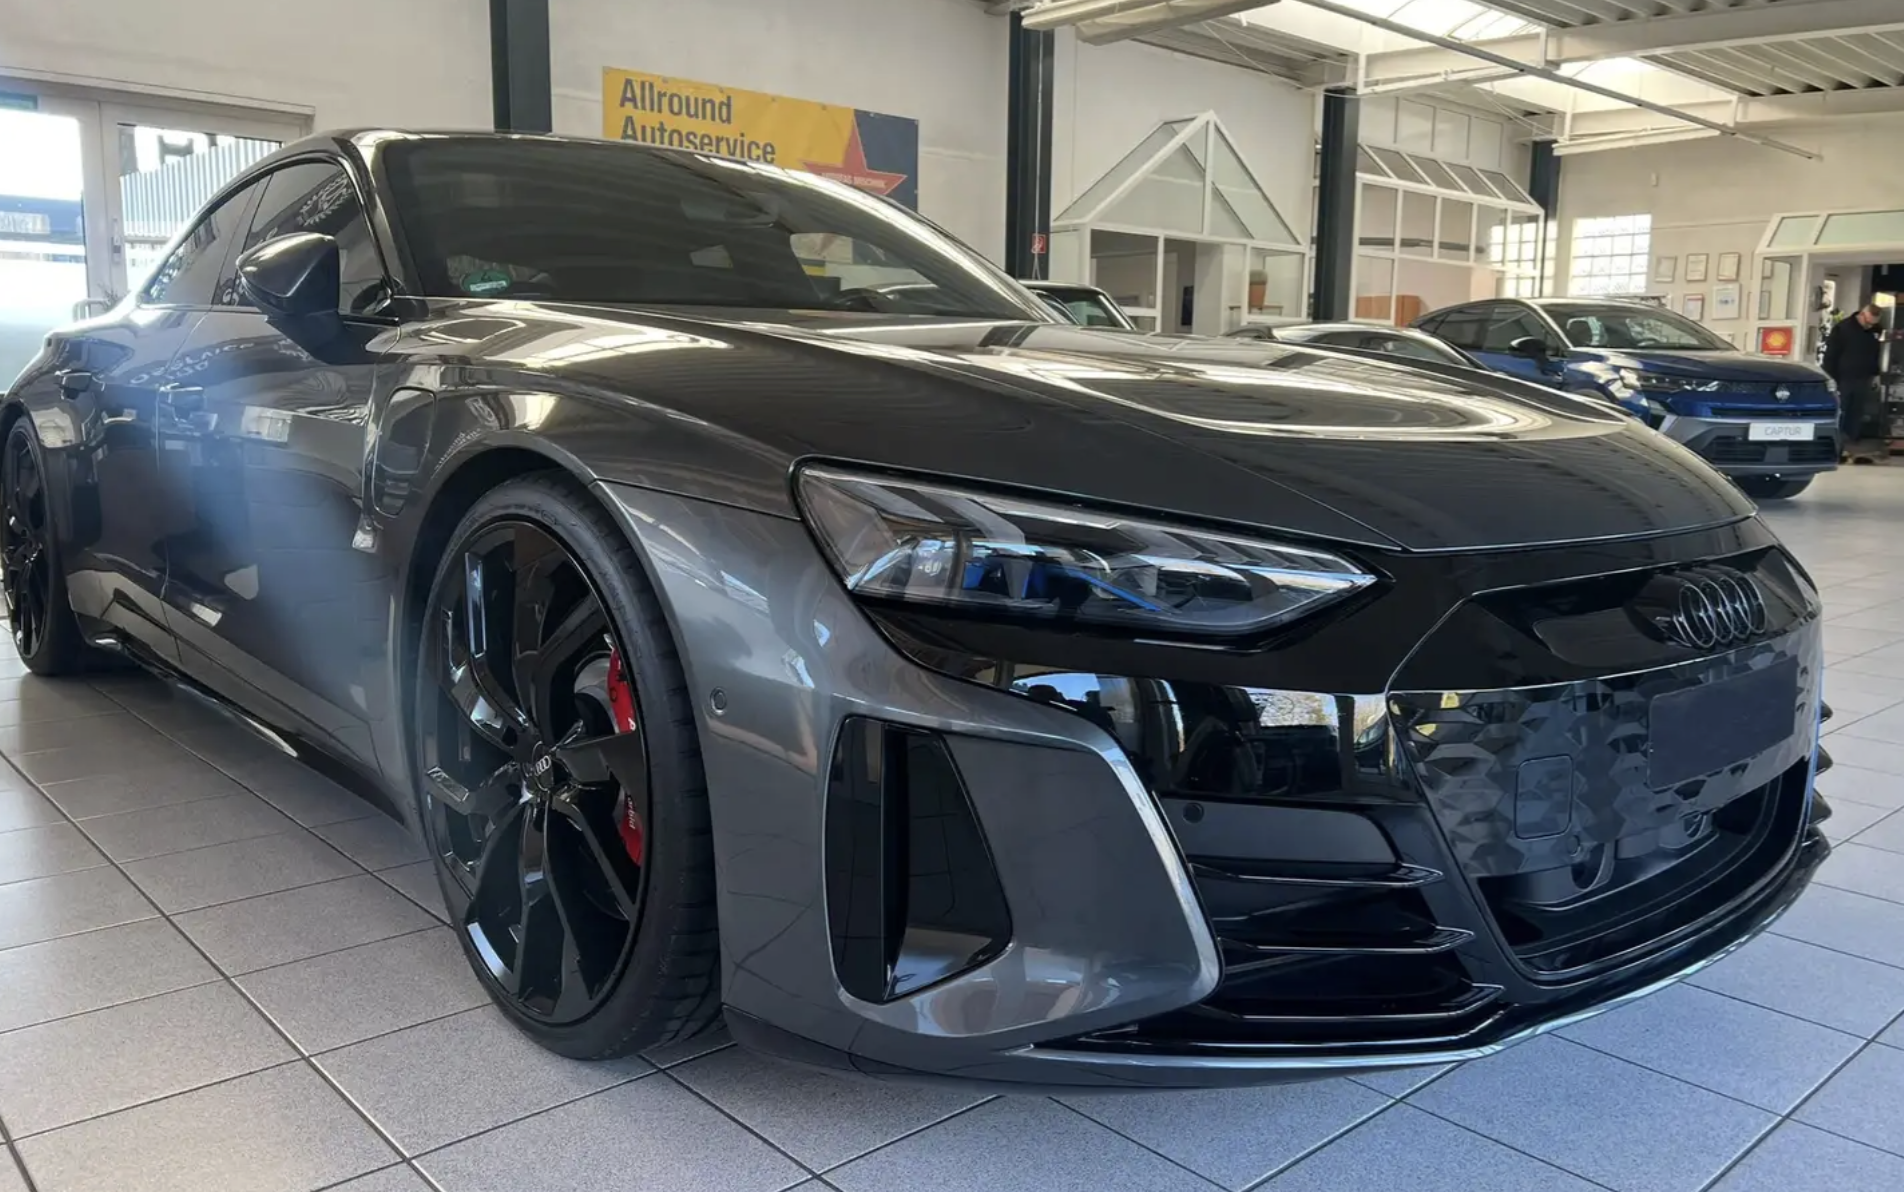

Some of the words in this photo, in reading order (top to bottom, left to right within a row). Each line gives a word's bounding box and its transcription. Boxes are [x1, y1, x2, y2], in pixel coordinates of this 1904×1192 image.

[619, 77, 732, 125] Allround
[620, 115, 776, 164] Autoservice
[1764, 426, 1802, 436] CAPTUR
